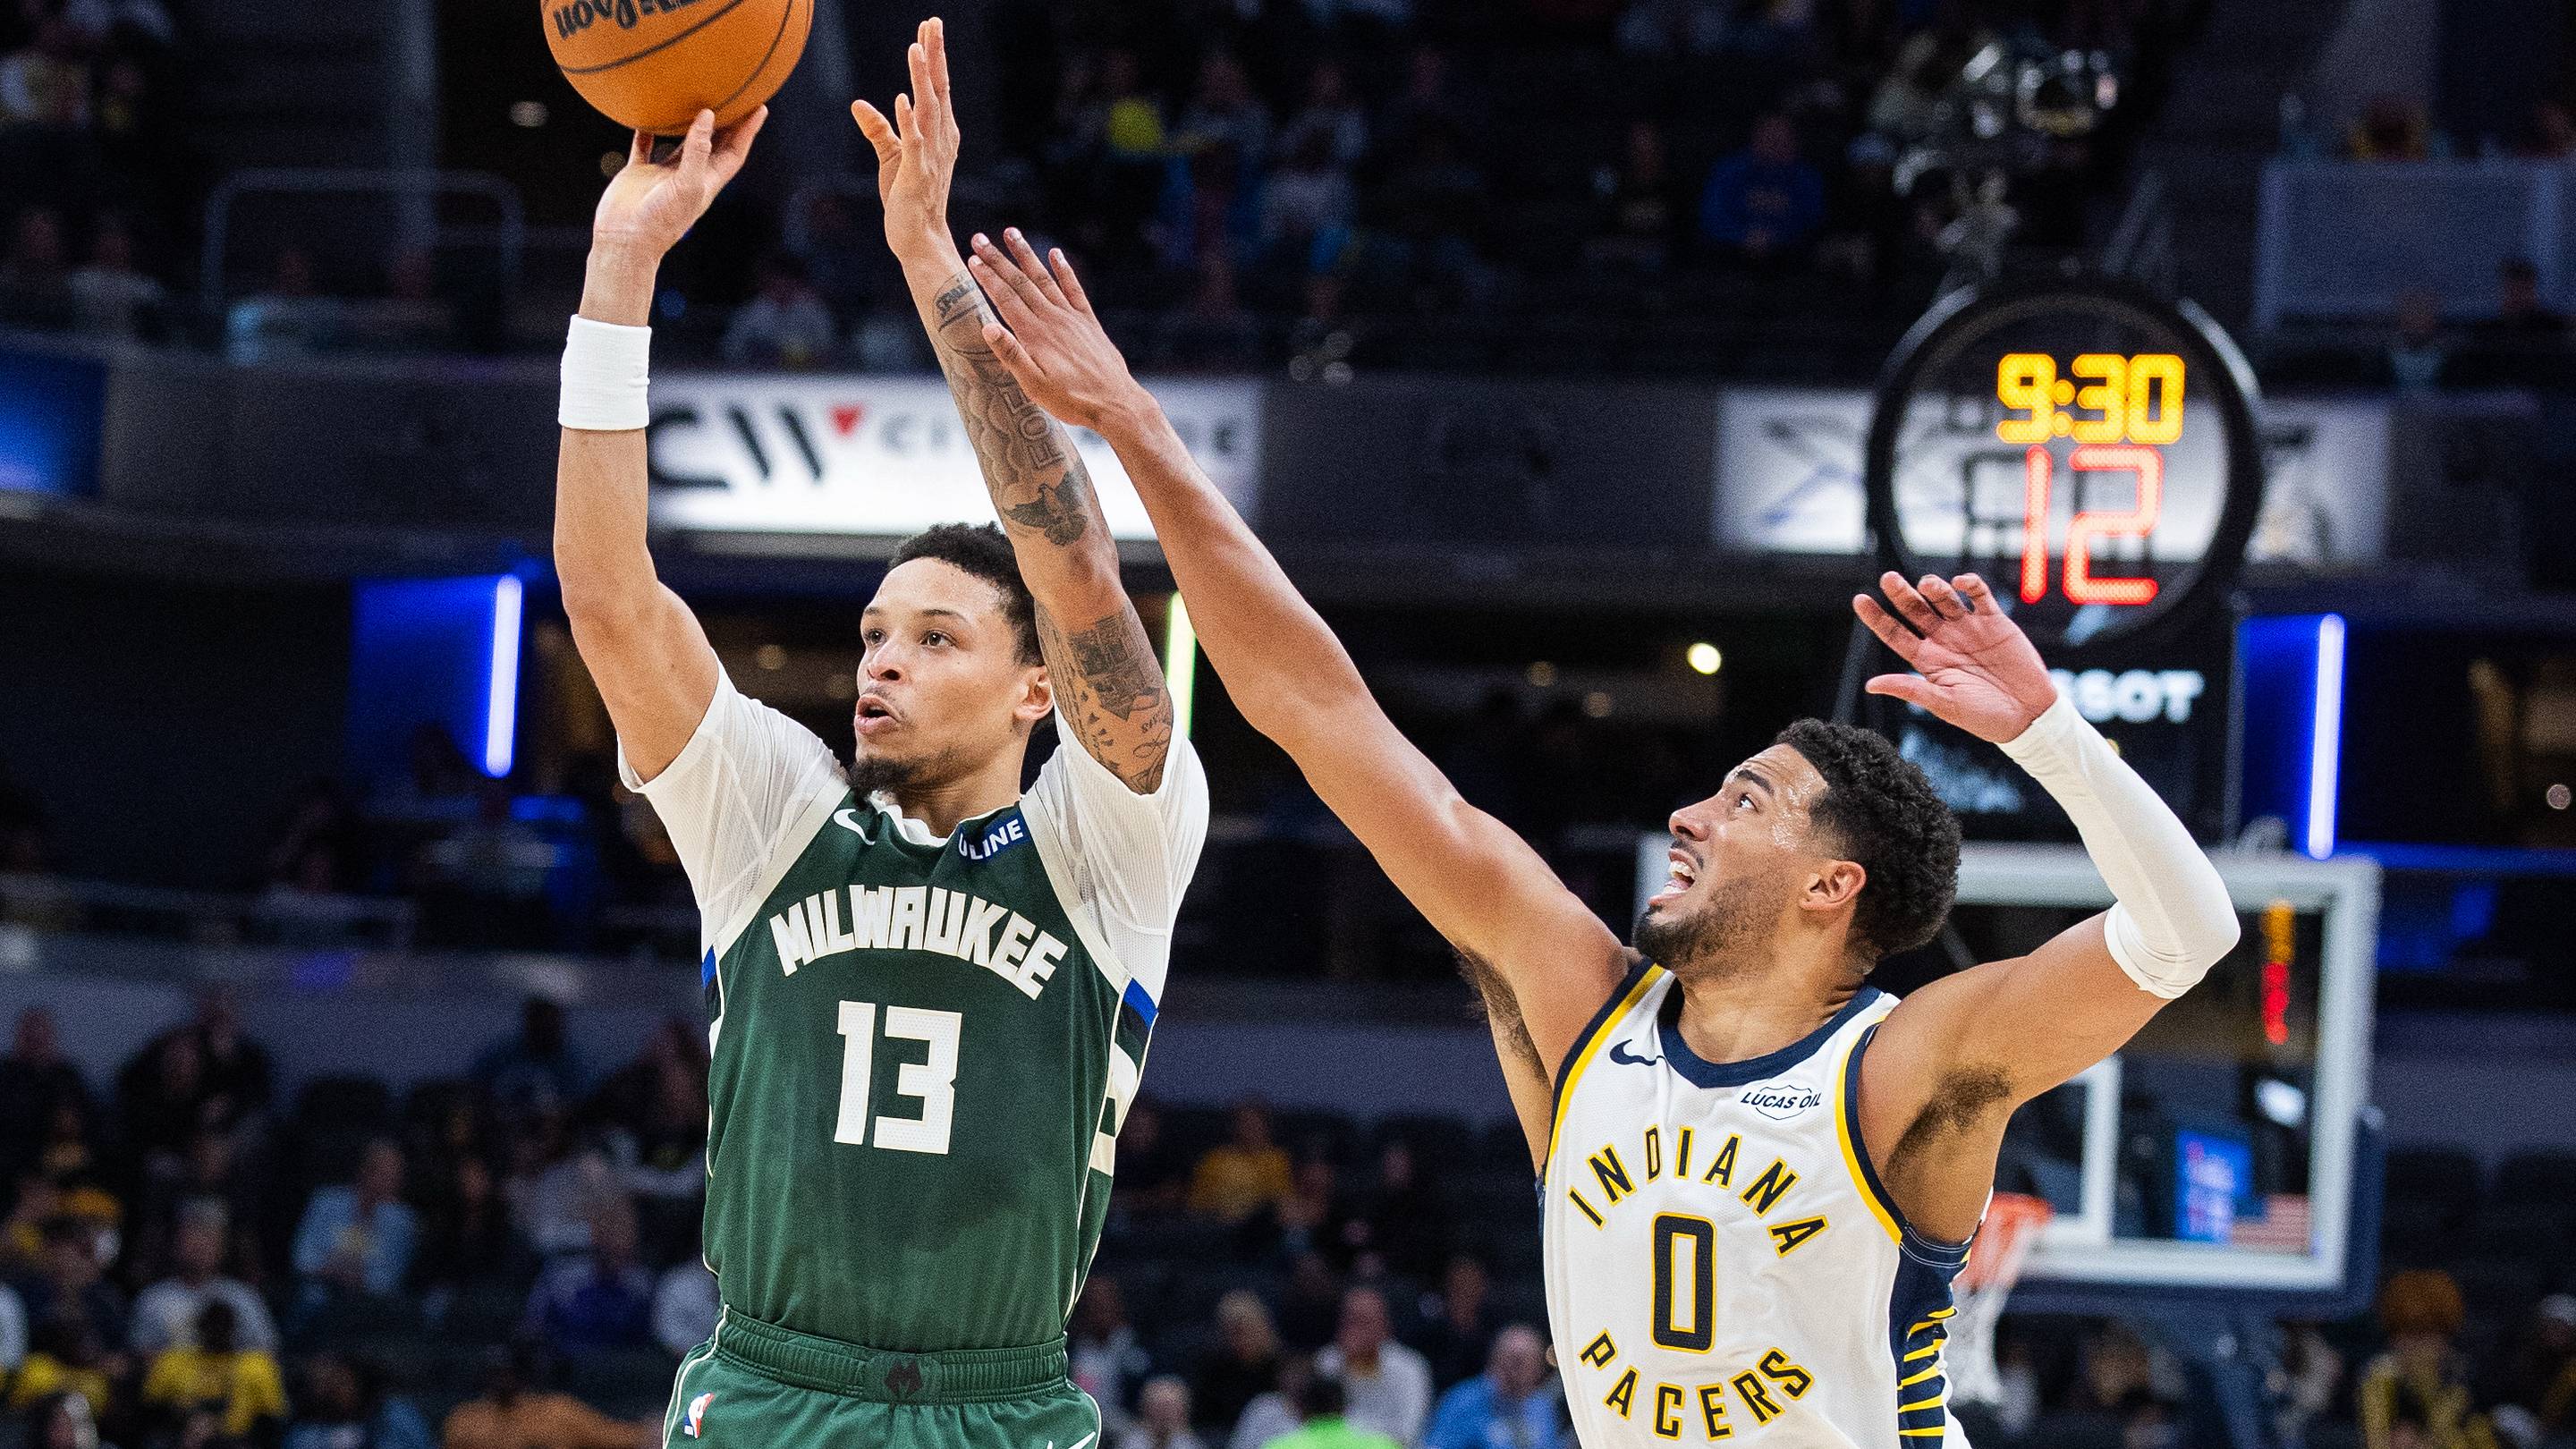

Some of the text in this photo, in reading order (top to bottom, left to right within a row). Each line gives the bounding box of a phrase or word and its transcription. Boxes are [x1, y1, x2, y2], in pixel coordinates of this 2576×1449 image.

[1996, 353, 2185, 444] 9:30
[2021, 445, 2164, 606] 12
[958, 818, 1024, 860] ULINE
[769, 885, 1068, 1000] MILWAUKEE
[834, 1000, 962, 1155] 13
[1740, 1091, 1822, 1109] LUCAS OIL
[1567, 1123, 1829, 1258] INDIANA
[1649, 1211, 1717, 1356] 0
[1578, 1328, 1814, 1442] PACERS
